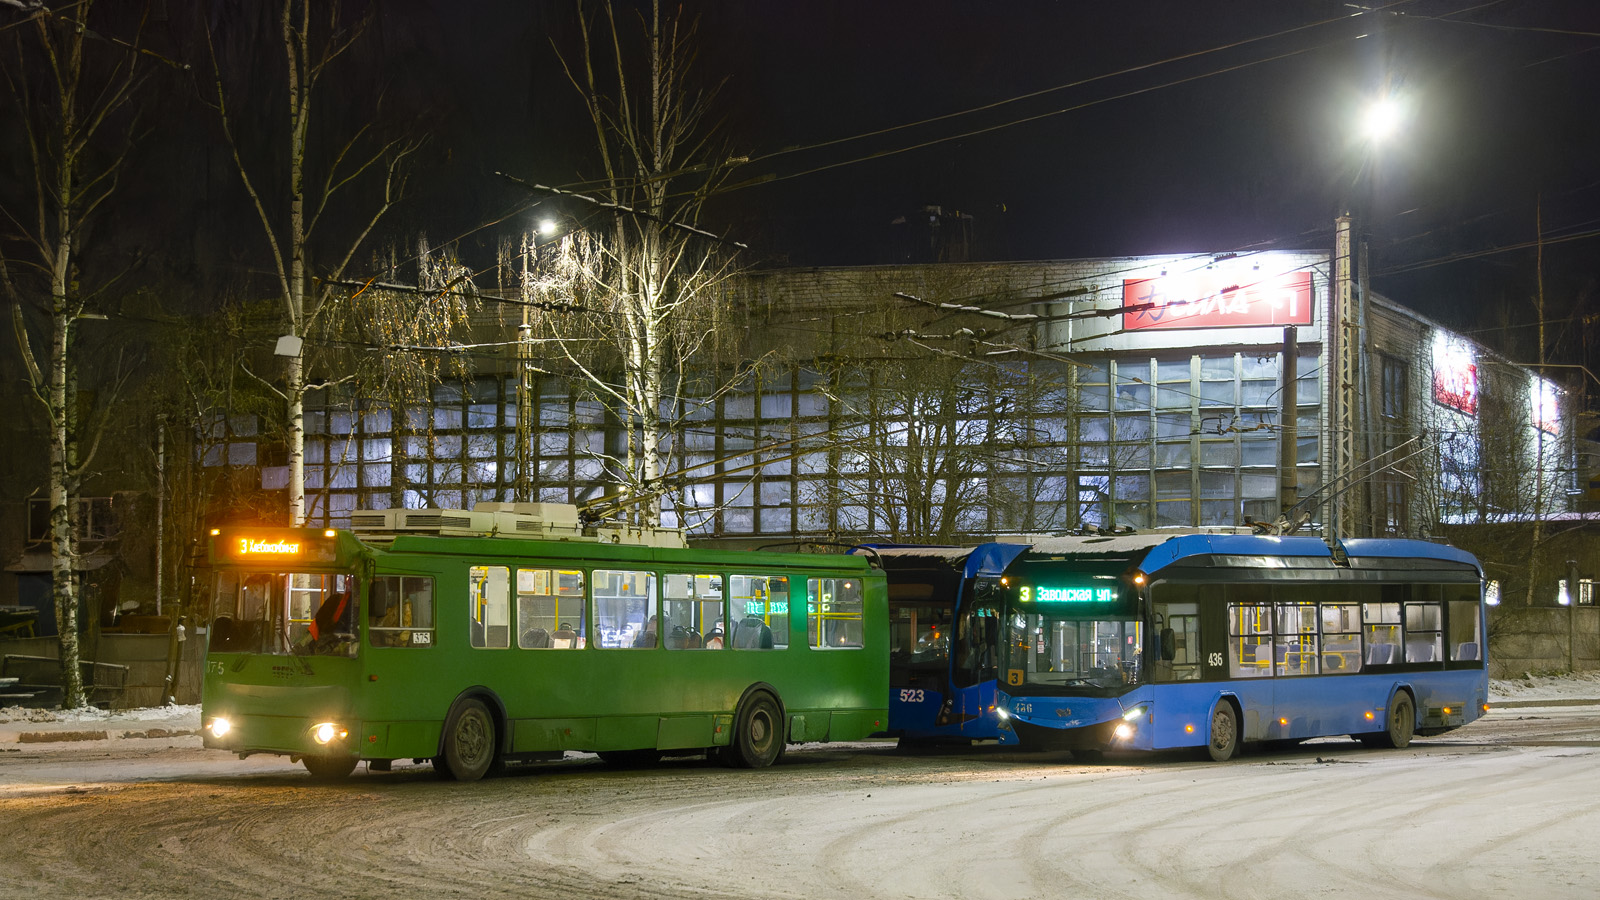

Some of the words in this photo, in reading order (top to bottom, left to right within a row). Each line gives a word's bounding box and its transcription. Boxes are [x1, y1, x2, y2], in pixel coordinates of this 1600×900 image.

[240, 539, 248, 553] 3
[1020, 586, 1030, 601] 3
[1037, 586, 1092, 602] Заводская
[414, 633, 430, 643] 375
[1208, 653, 1223, 666] 436
[1011, 672, 1019, 684] 3
[900, 689, 924, 702] 523
